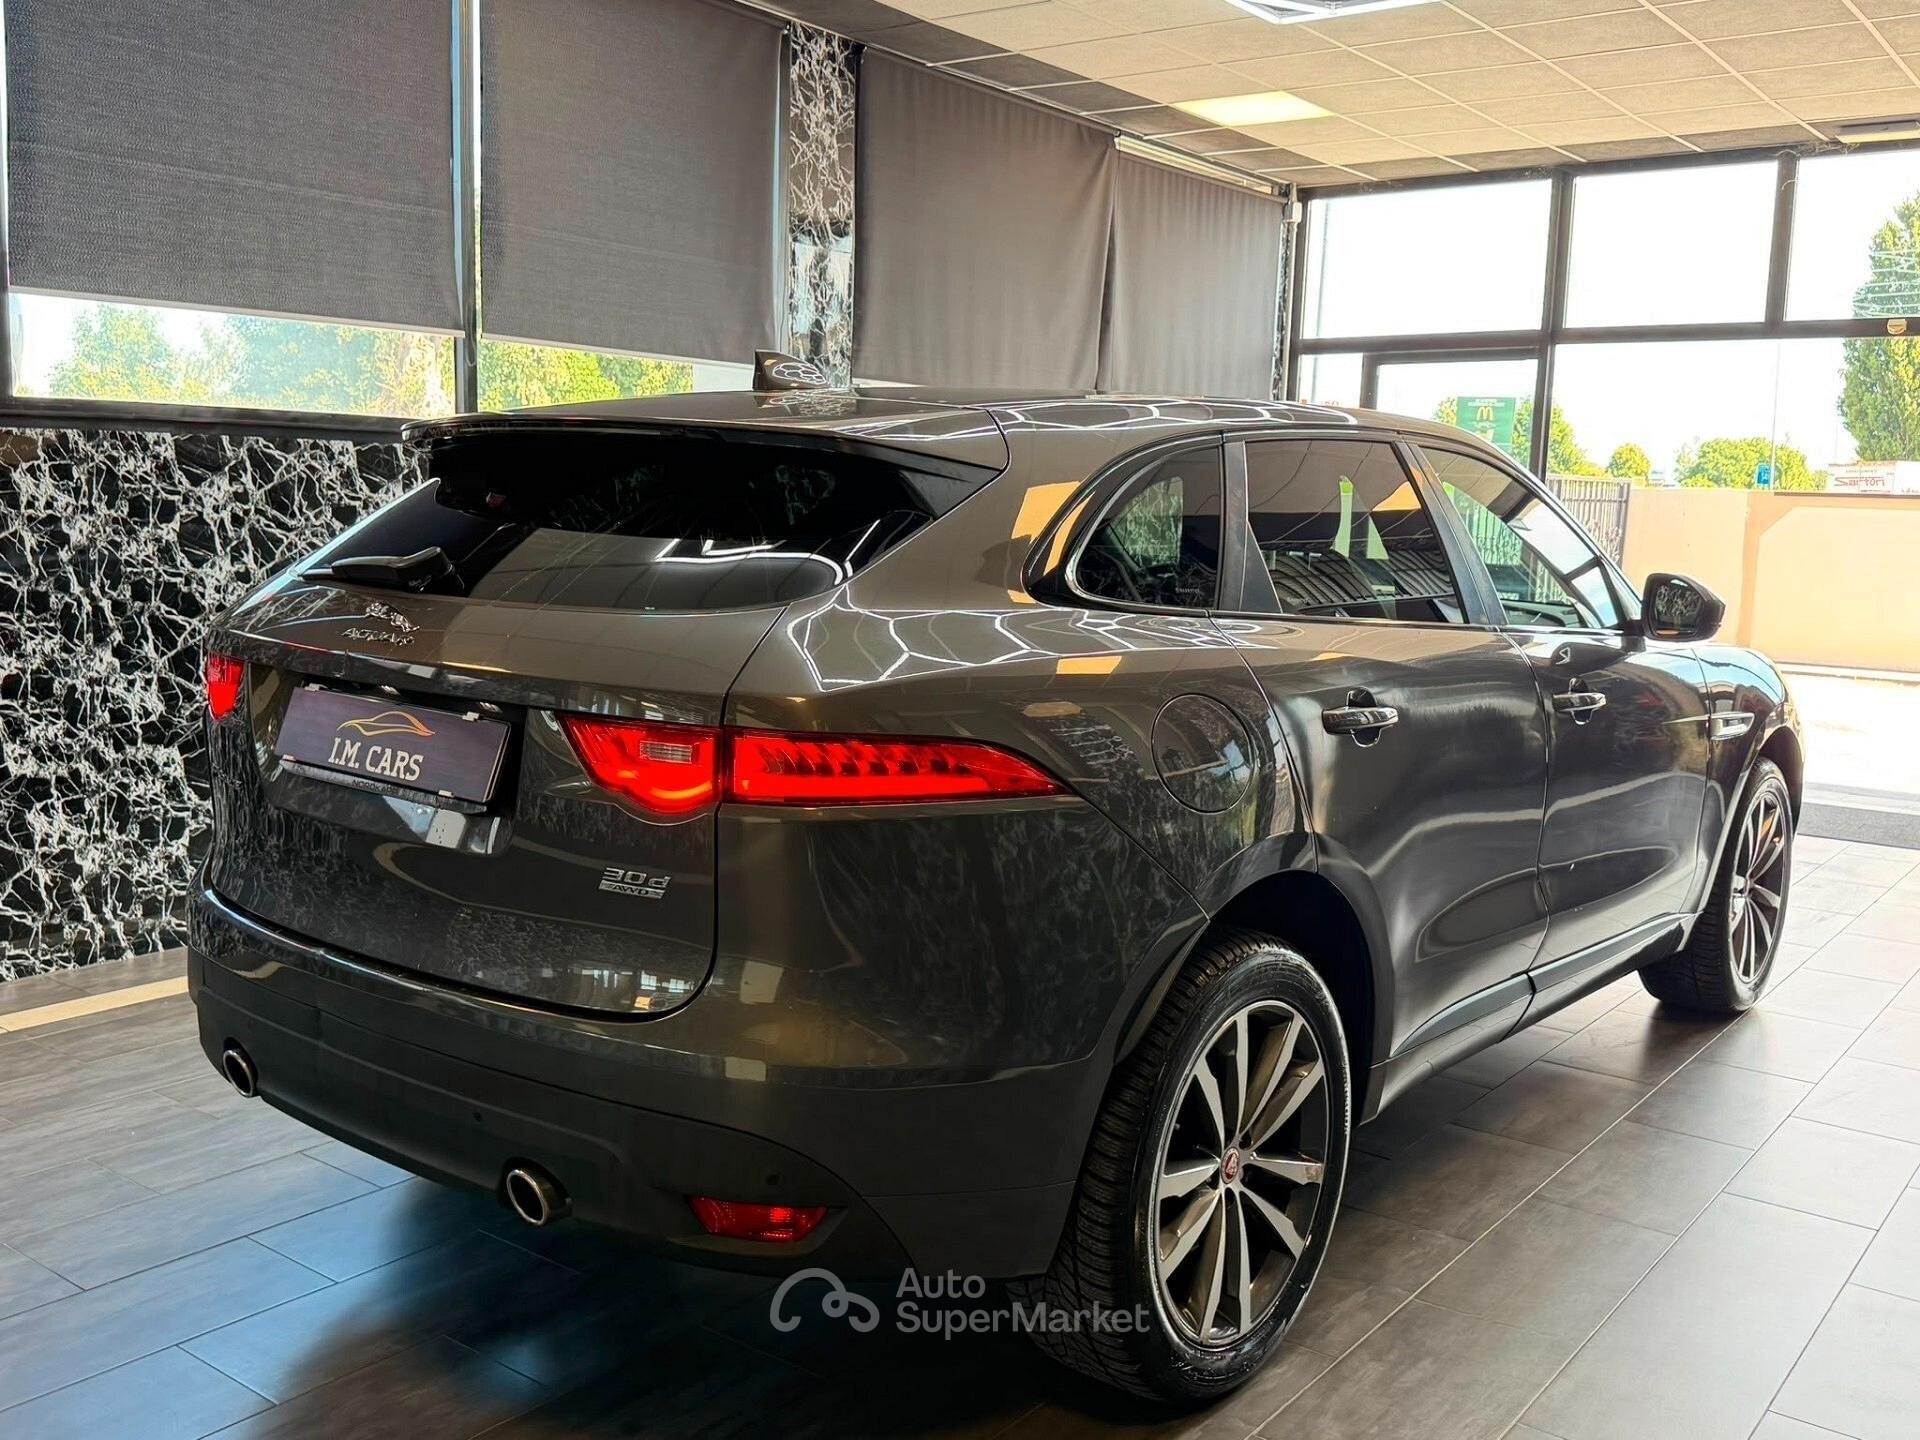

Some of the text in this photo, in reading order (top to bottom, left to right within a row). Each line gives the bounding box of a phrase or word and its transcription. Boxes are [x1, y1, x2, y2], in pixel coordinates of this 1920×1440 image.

[365, 745, 424, 781] CARS
[602, 867, 671, 888] 30d
[612, 885, 650, 896] AWD
